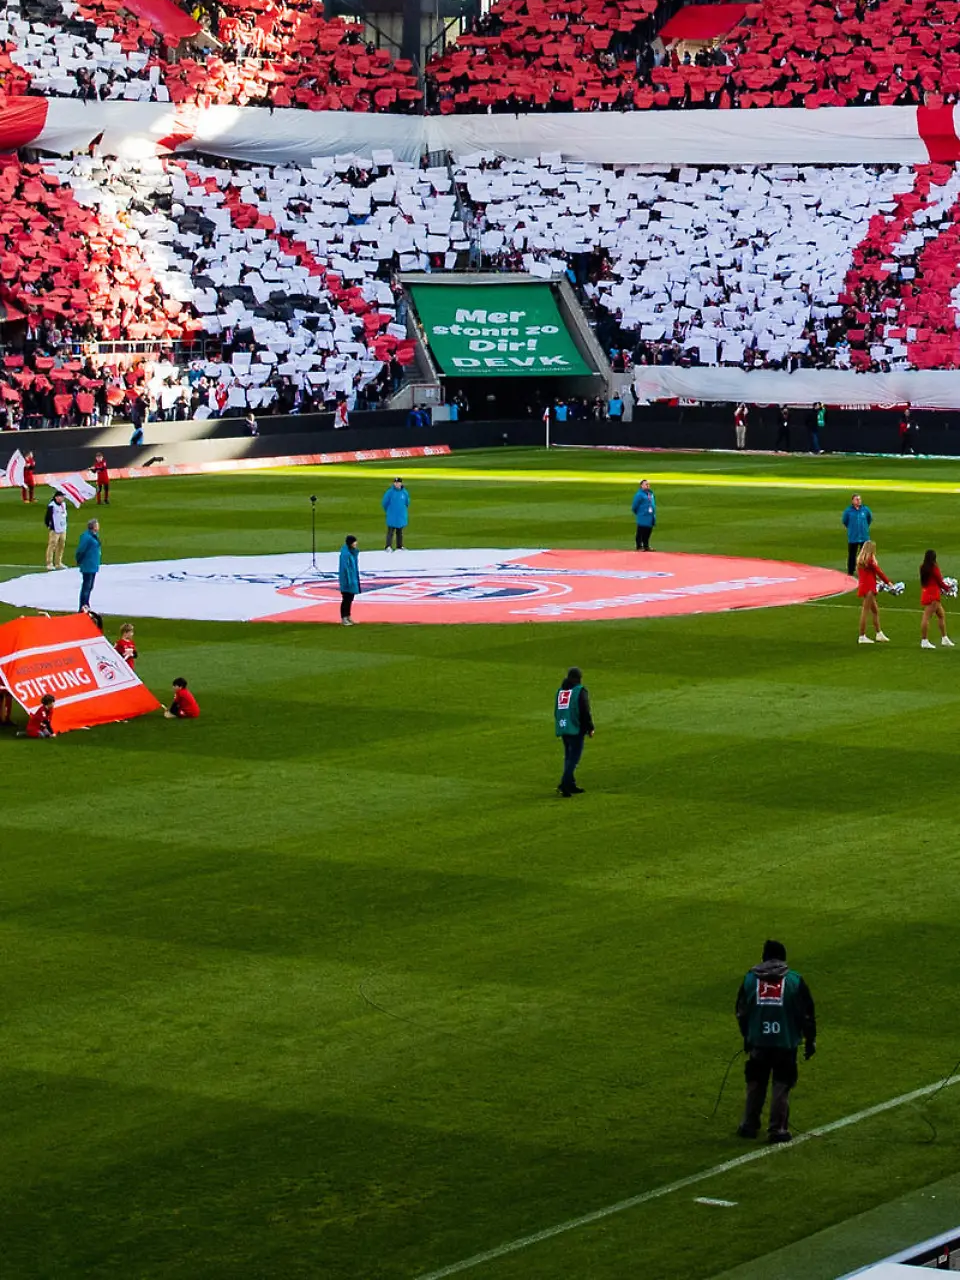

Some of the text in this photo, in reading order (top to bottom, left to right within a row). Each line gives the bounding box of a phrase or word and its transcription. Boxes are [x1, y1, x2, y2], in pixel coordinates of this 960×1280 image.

[455, 308, 526, 323] Mer
[432, 324, 559, 336] stonn zo
[468, 339, 538, 352] Dir!
[451, 355, 570, 367] DEVK
[14, 667, 91, 702] STIFTUNG
[762, 1021, 781, 1034] 30
